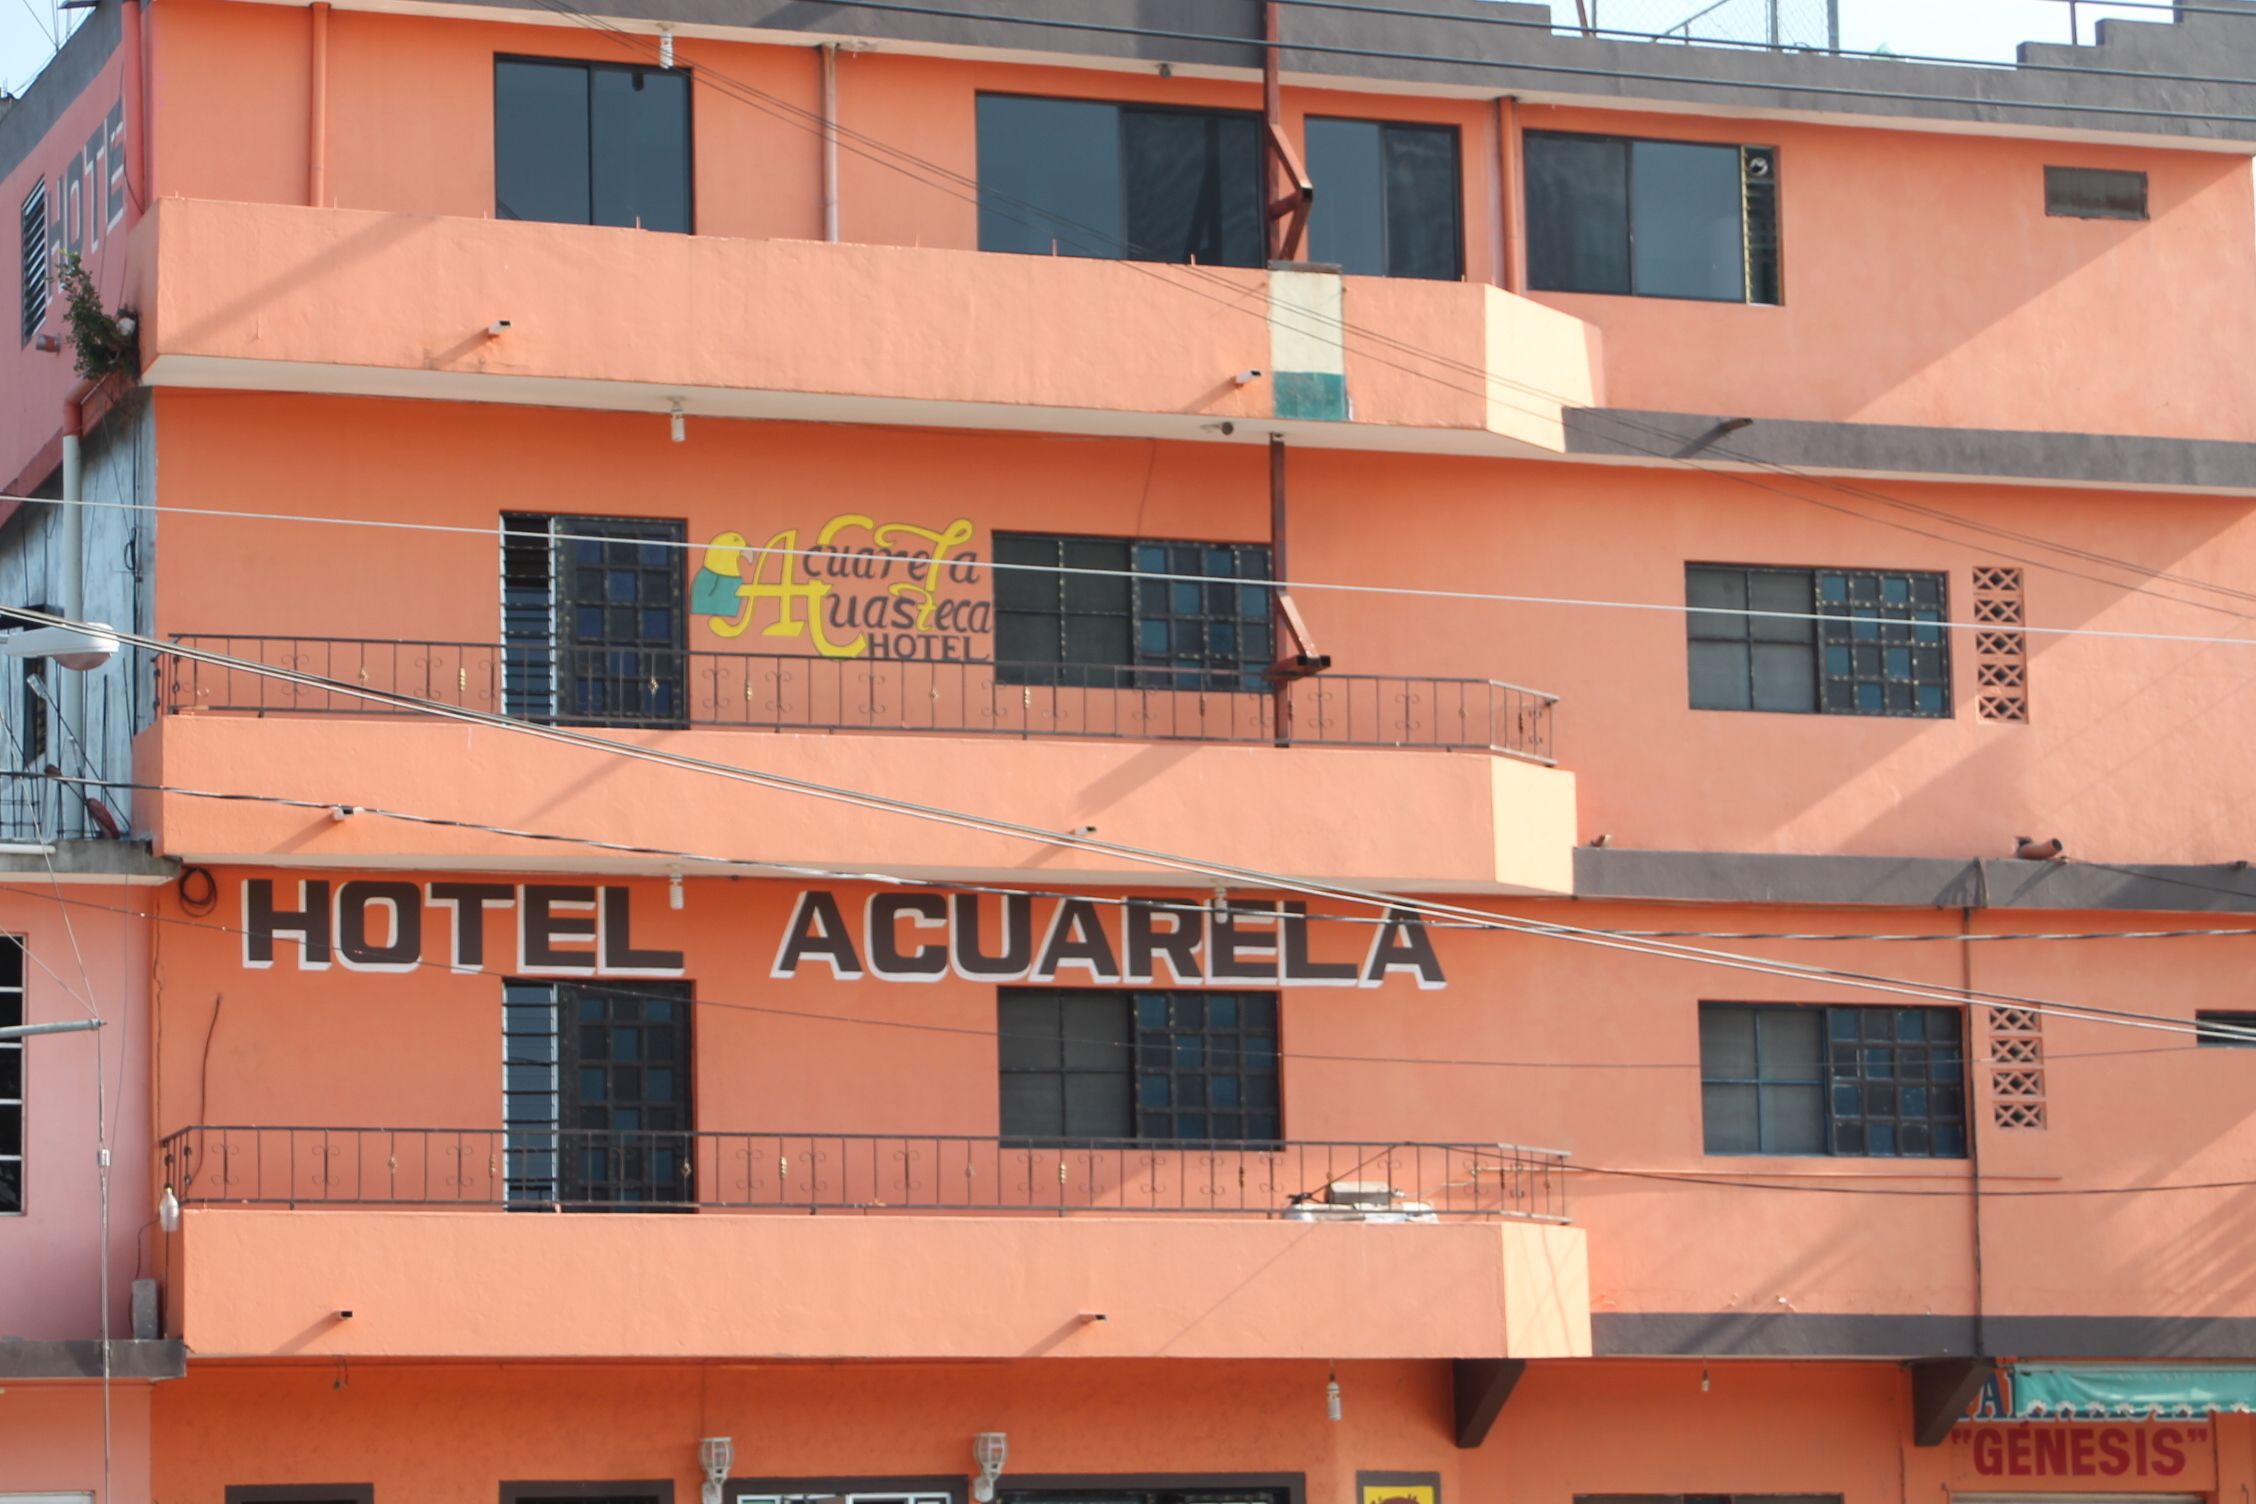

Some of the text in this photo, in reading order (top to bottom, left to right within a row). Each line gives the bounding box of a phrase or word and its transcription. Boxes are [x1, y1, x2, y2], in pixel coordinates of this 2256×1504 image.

[868, 632, 990, 661] HOTEL
[241, 878, 1447, 990] HOTEL ACUARELA
